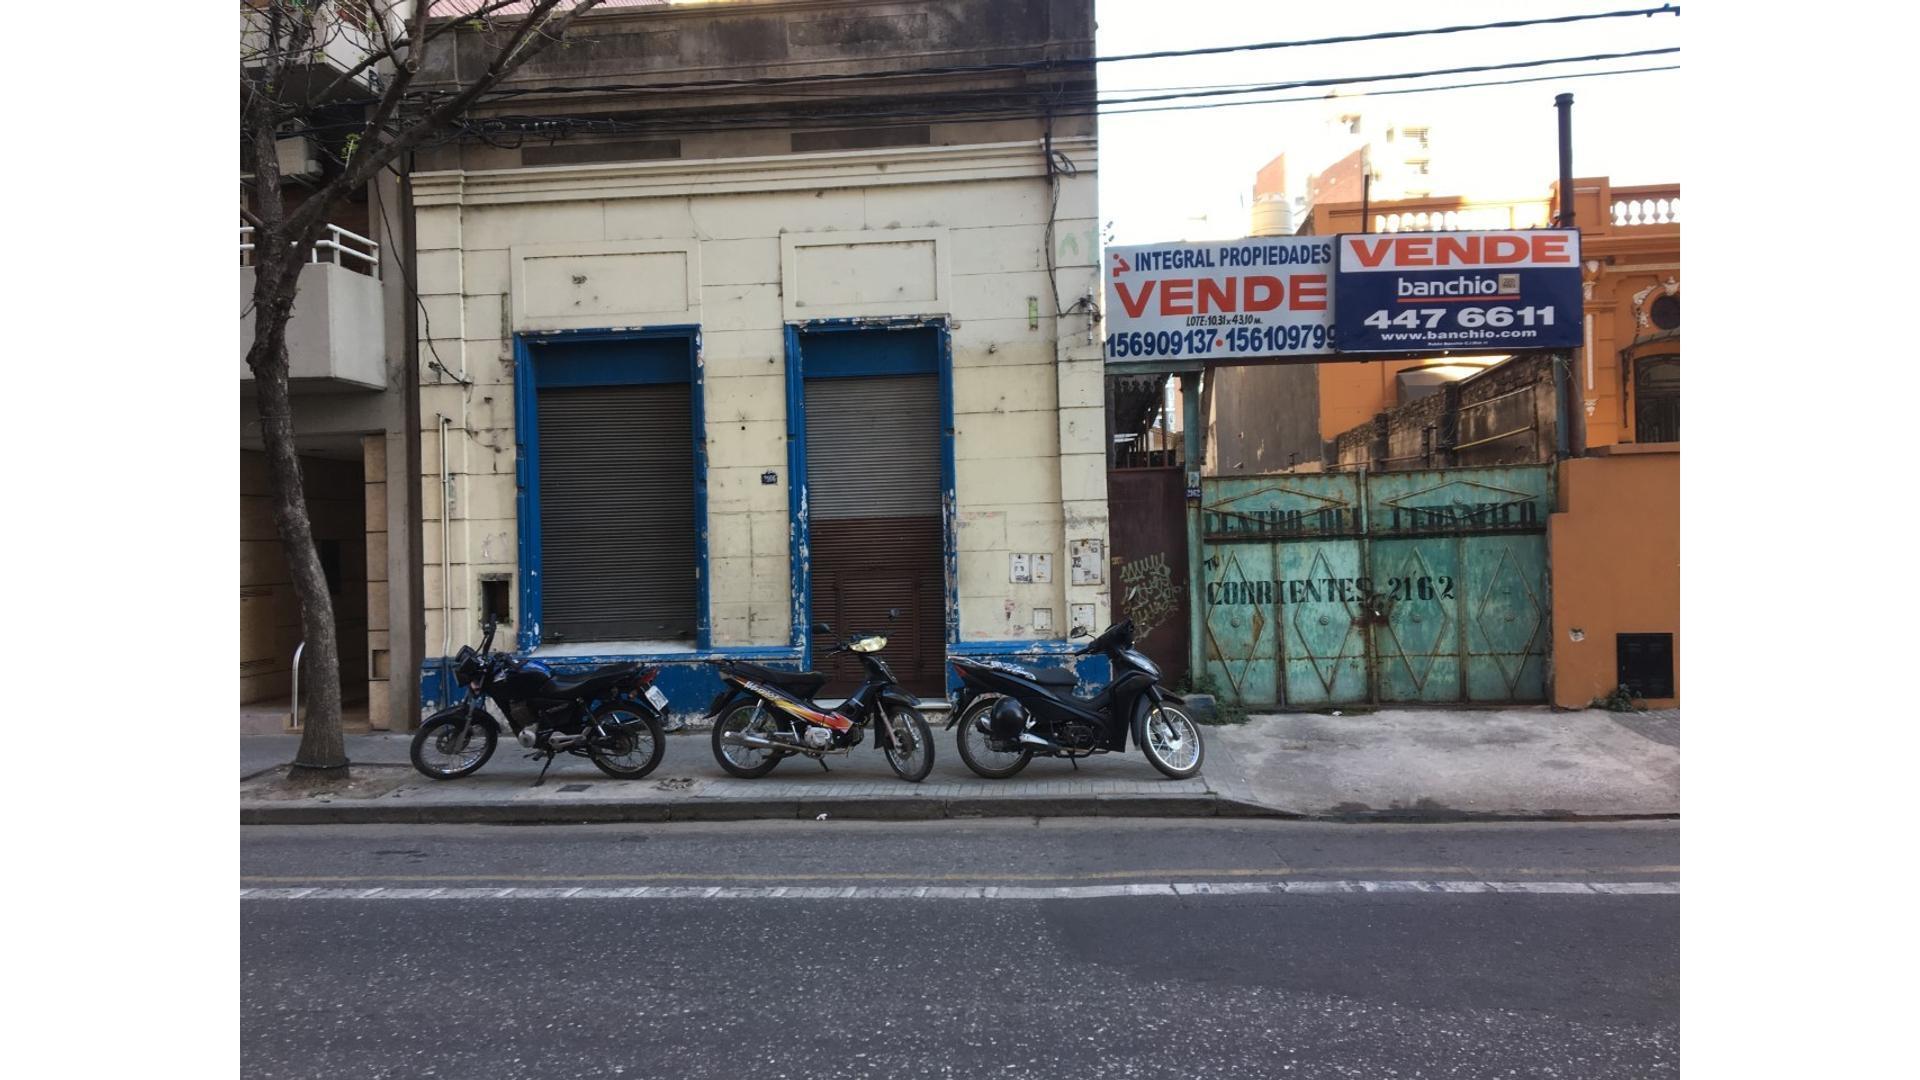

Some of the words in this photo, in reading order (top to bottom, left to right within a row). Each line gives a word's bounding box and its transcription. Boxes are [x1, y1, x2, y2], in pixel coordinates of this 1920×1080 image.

[1135, 247, 1215, 271] INTEGRAL
[1219, 243, 1332, 267] PROPIEDADES
[1349, 235, 1570, 267] VENDE
[1114, 274, 1328, 318] VENDE
[1397, 275, 1498, 296] banchio
[1363, 308, 1447, 329] 447
[1457, 305, 1554, 328] 6611
[1106, 328, 1218, 357] 156909137
[1225, 323, 1336, 352] 156109799
[1381, 329, 1537, 341] www.banchio.com
[1206, 577, 1374, 605] CORRIENTES
[1387, 575, 1455, 601] 2162
